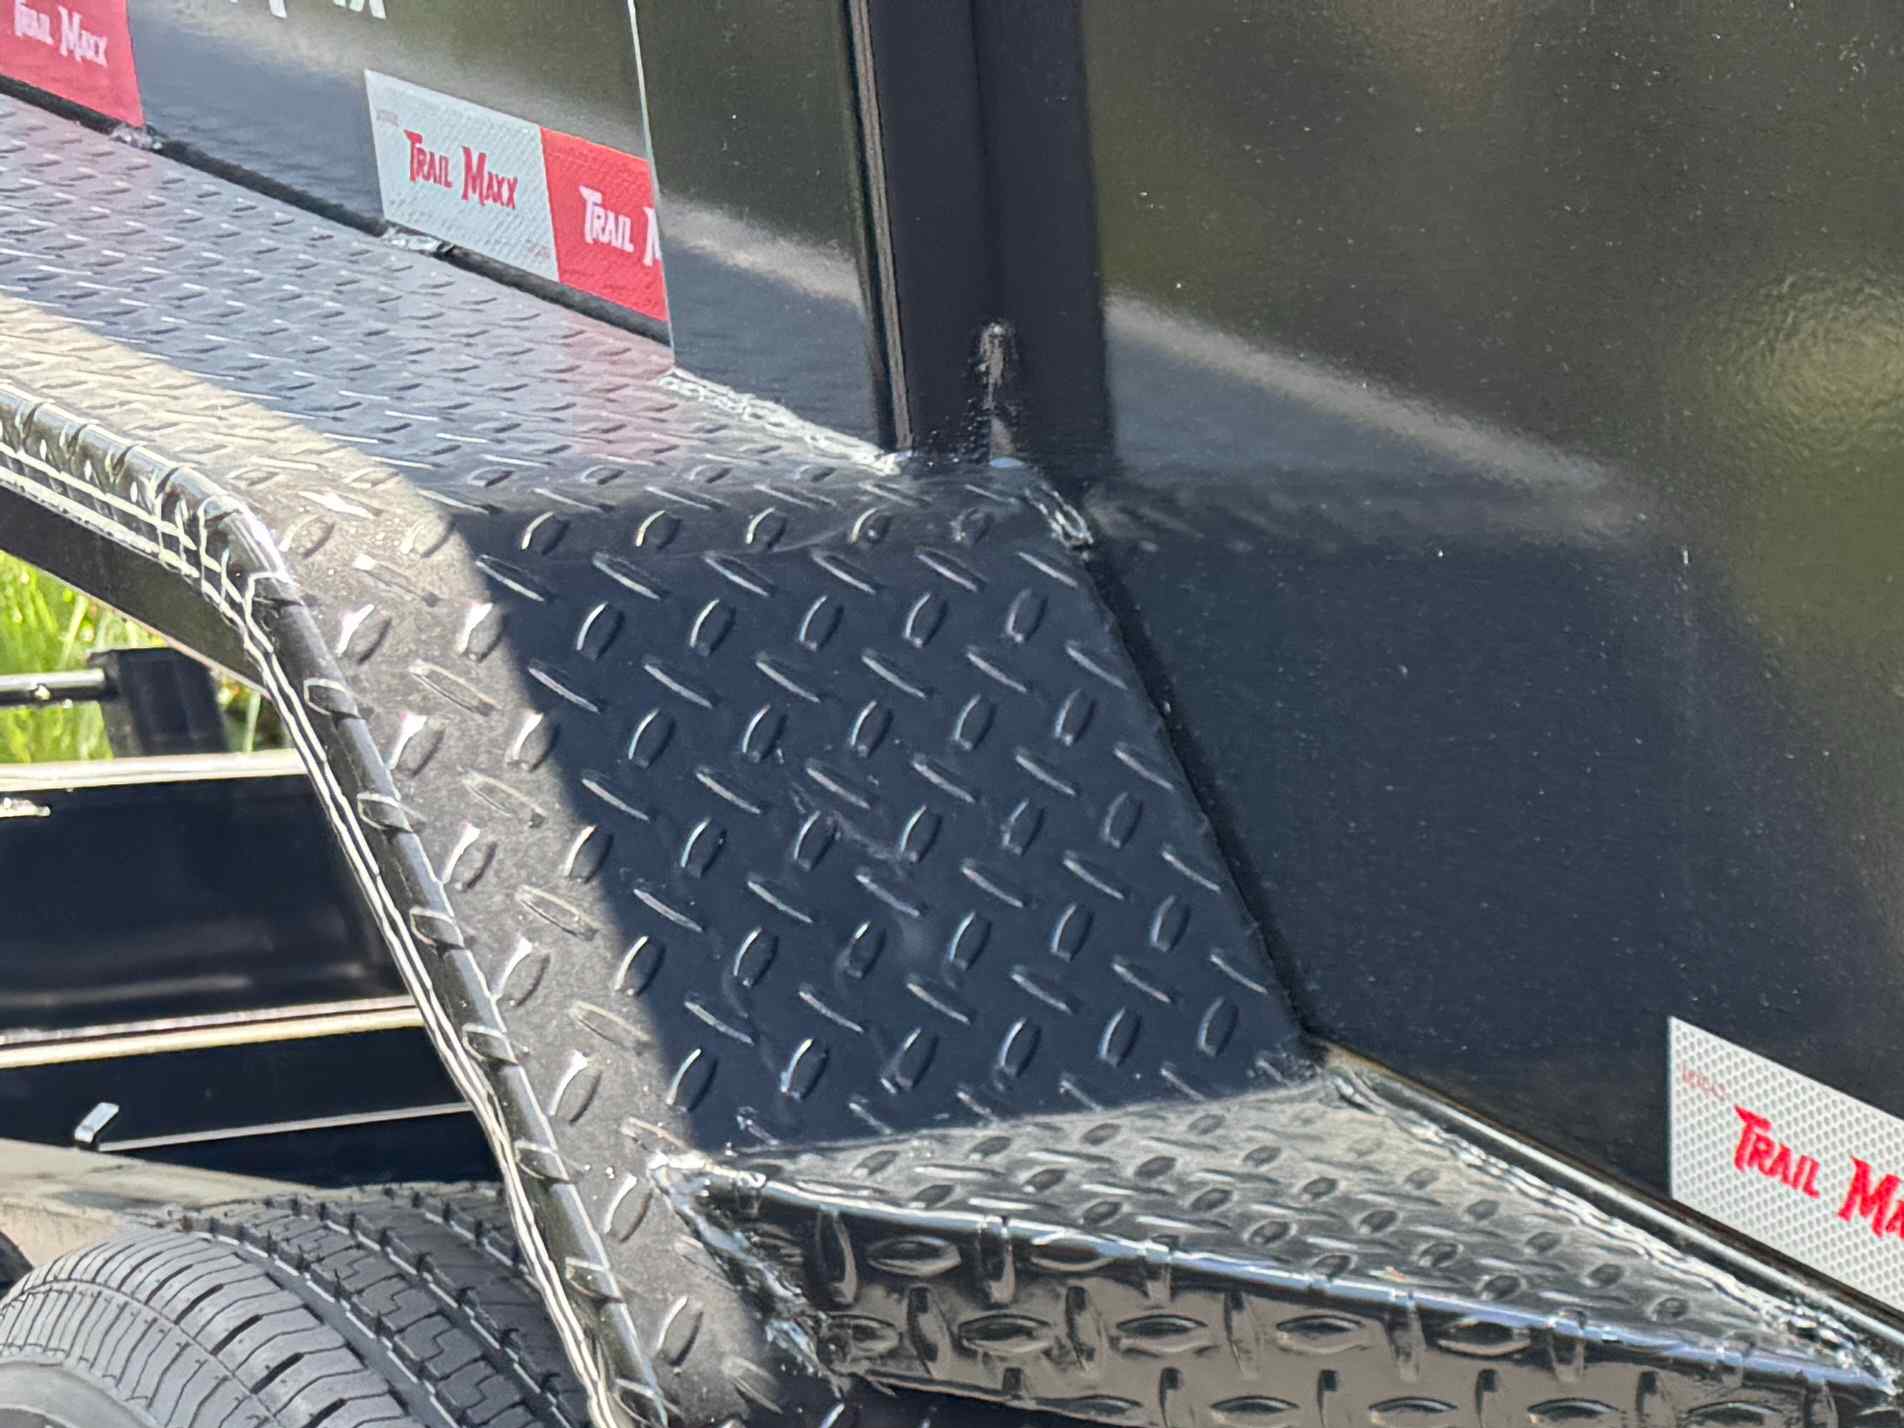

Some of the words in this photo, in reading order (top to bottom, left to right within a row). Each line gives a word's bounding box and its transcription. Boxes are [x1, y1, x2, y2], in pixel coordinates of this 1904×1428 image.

[404, 128, 453, 189] TRAIL
[461, 145, 519, 210] MAXX
[579, 184, 634, 253] TRAIL
[1733, 1104, 1821, 1199] TRAIL
